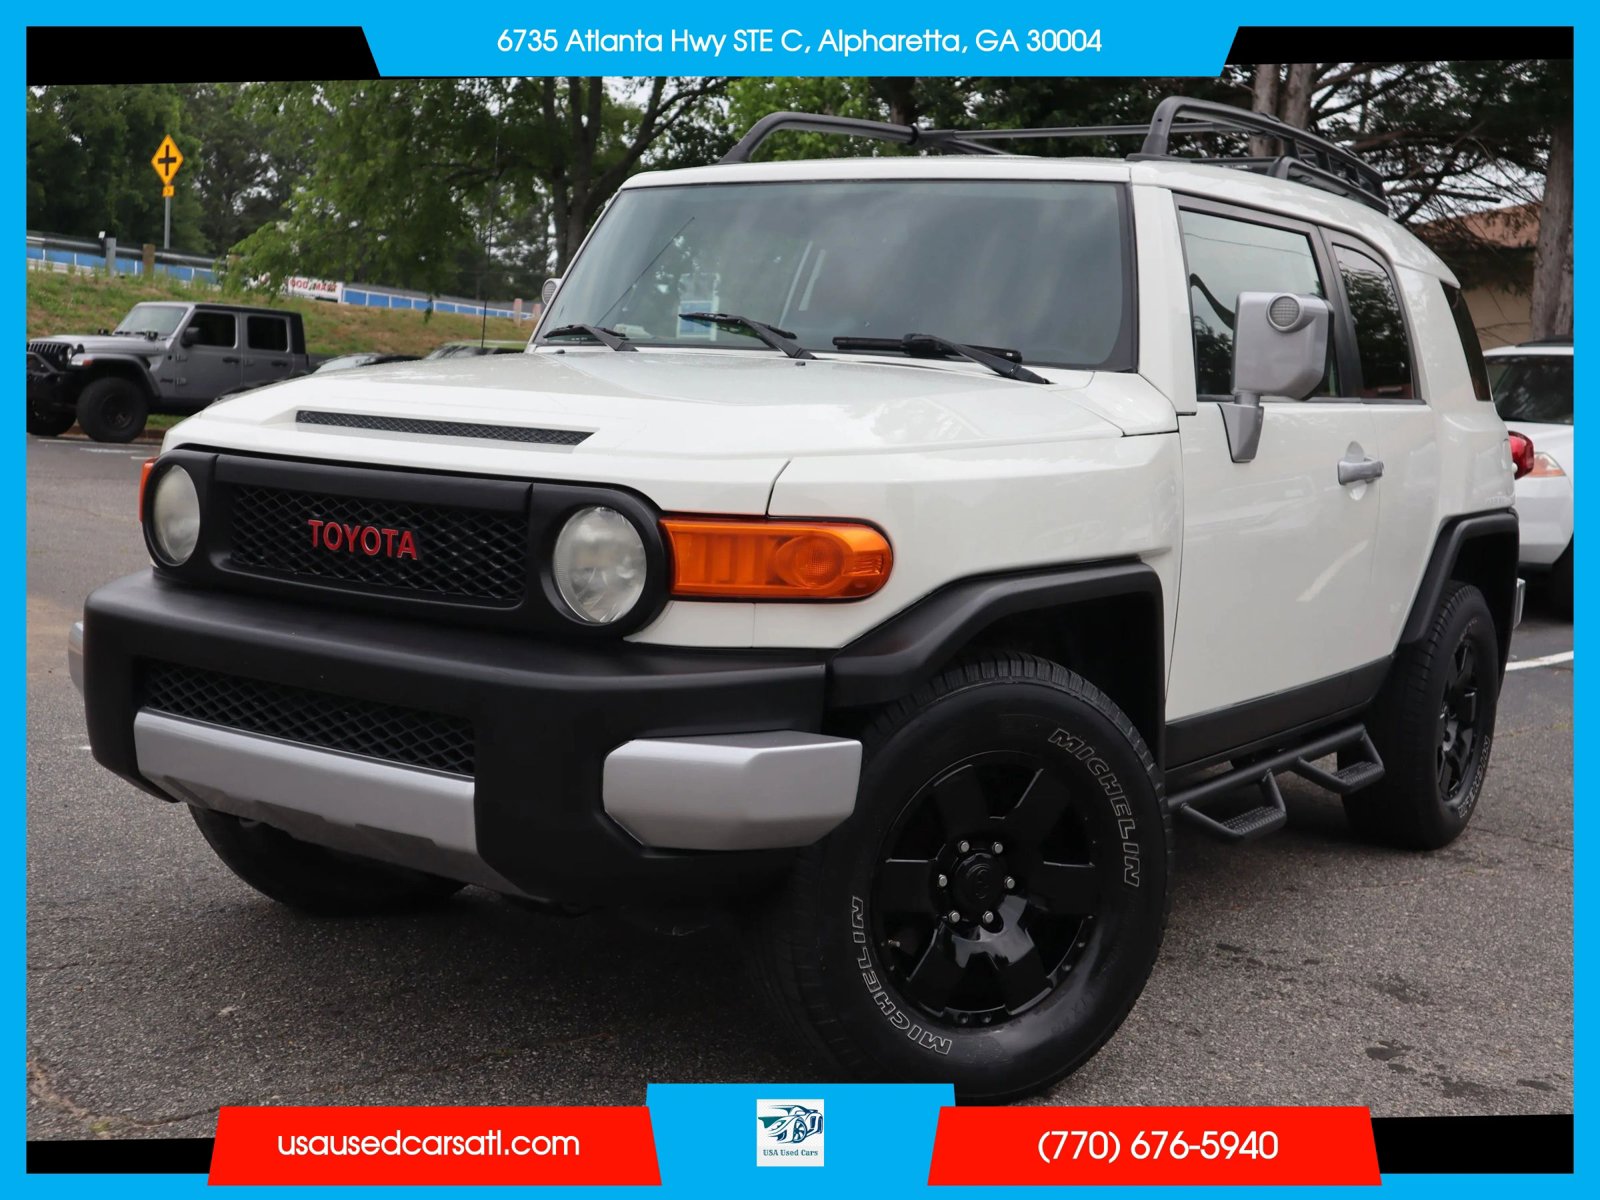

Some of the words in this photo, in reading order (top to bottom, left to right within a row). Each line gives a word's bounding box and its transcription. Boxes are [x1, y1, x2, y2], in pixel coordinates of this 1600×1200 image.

[307, 519, 418, 560] TOYOTA
[1047, 727, 1141, 888] MICHELIN
[851, 895, 953, 1055] MICHELIN
